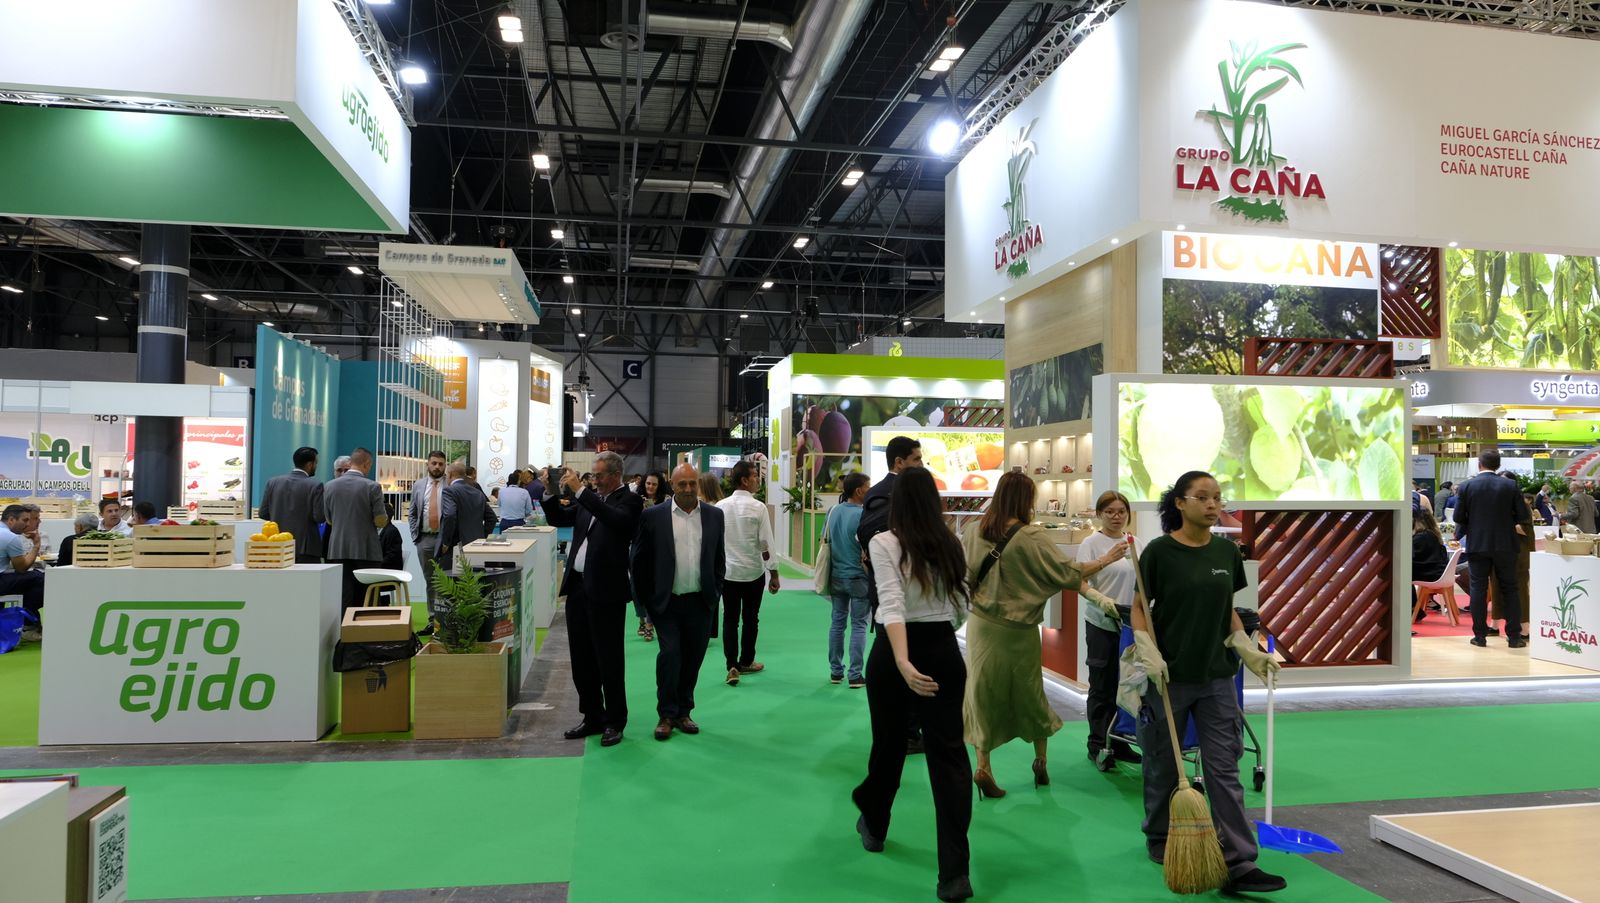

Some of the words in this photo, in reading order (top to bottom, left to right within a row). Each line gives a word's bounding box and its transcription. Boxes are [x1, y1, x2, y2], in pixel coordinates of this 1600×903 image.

[1440, 124, 1490, 141] MIGUEL
[1493, 128, 1541, 145] GARCÍA
[1543, 131, 1600, 150] SÁNCHEZ
[1176, 147, 1231, 162] GRUPO
[1440, 142, 1531, 162] EUROCASTELL
[1533, 149, 1568, 165] CAÑA
[1440, 159, 1477, 175] CAÑA
[1480, 164, 1531, 180] NATURE
[1176, 164, 1220, 191] LA
[1230, 166, 1326, 199] CAÑA
[385, 250, 428, 264] Campos
[431, 252, 444, 264] de
[447, 253, 491, 266] Granada
[995, 246, 1008, 270] LA
[1010, 224, 1042, 260] CAÑA
[627, 363, 638, 376] C
[272, 366, 305, 401] Campos
[1533, 381, 1599, 399] syngenta
[271, 395, 283, 420] de
[0, 480, 45, 490] AGRUPACIN
[44, 480, 71, 490] CAMPOS
[89, 600, 246, 666] agro
[1541, 620, 1561, 628] GRUPO
[1540, 627, 1557, 639] LA
[1560, 630, 1598, 646] CAÑA
[119, 657, 276, 723] ejido
